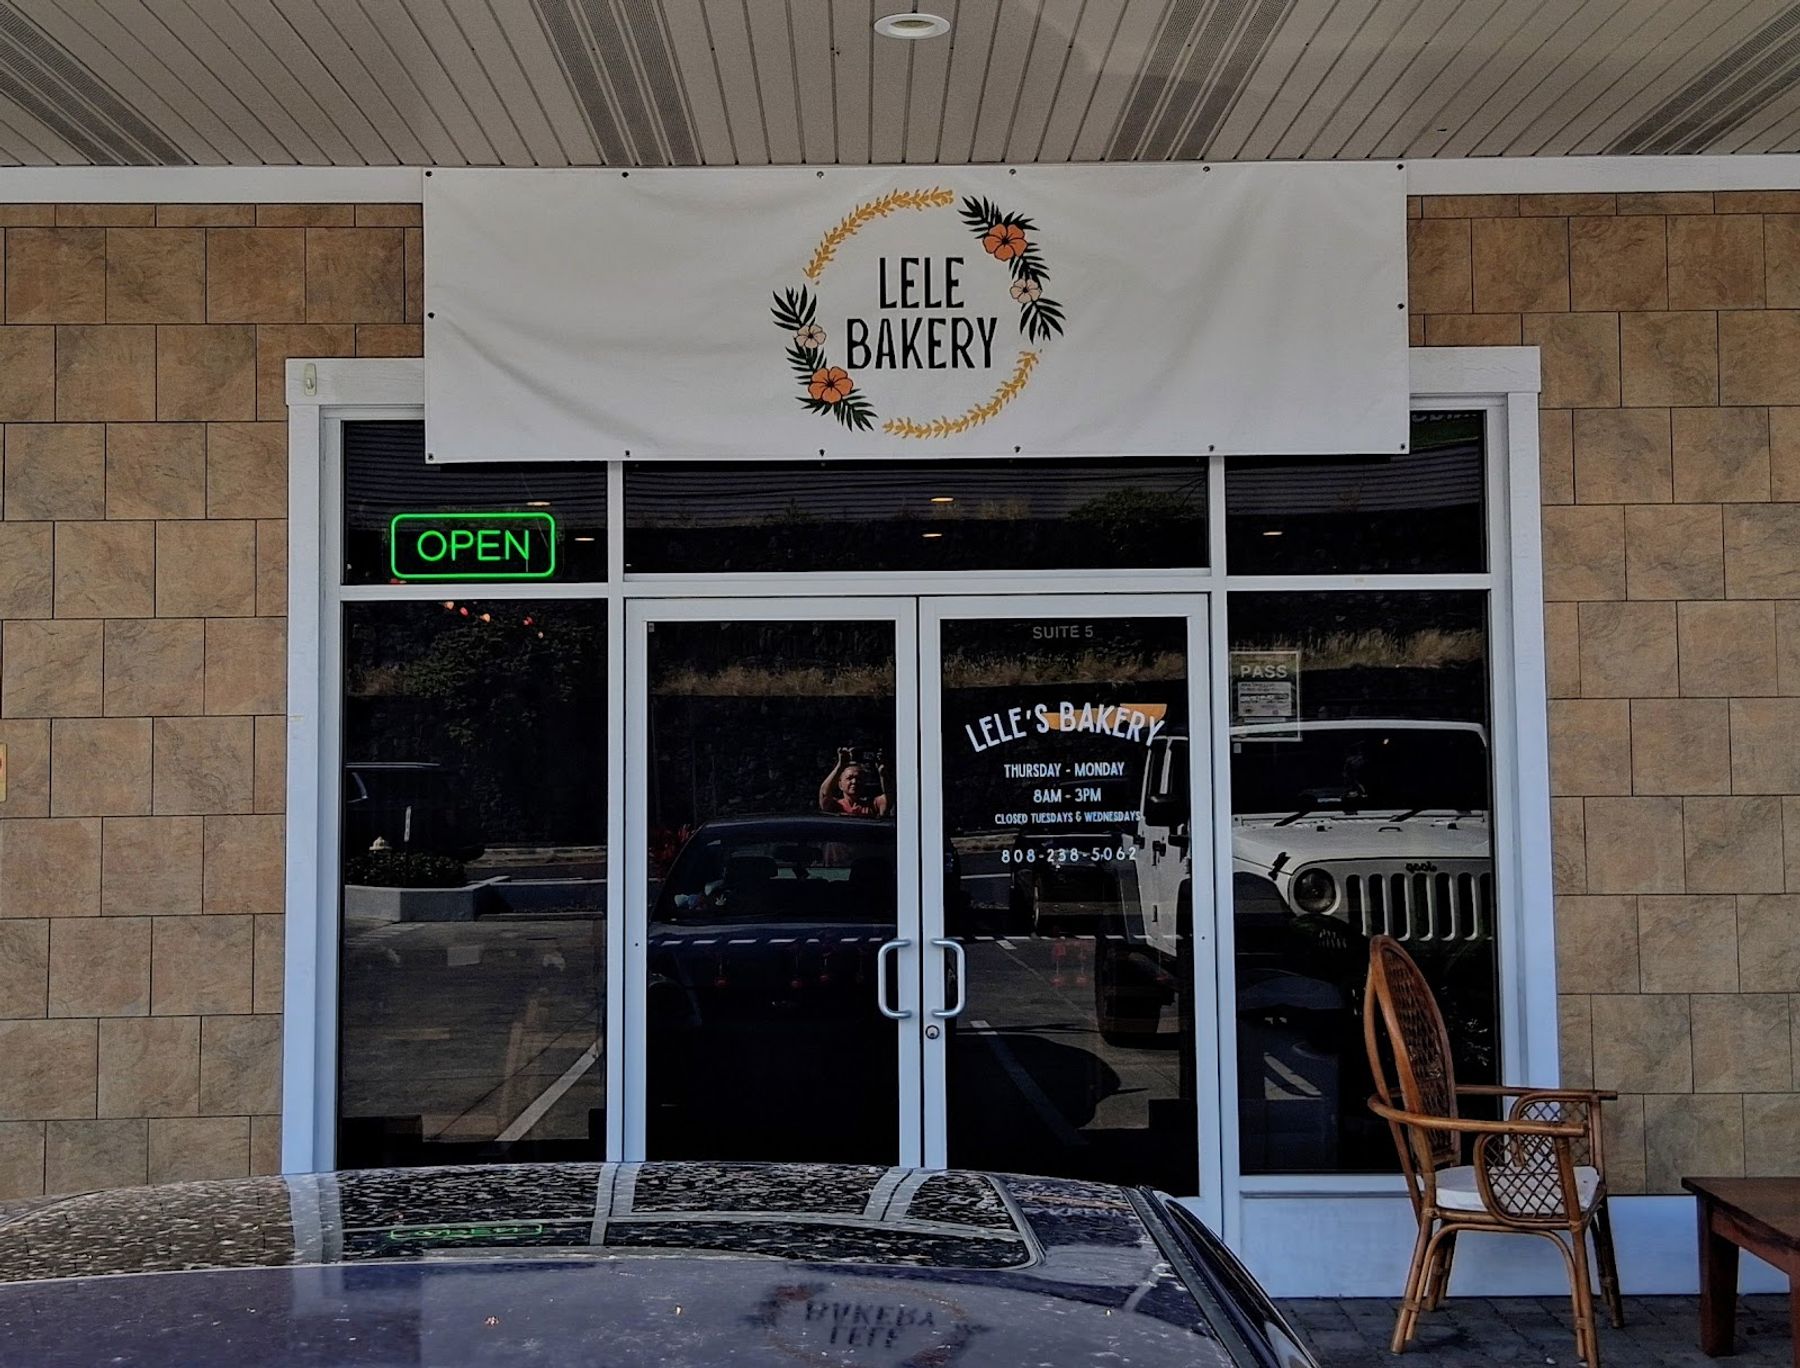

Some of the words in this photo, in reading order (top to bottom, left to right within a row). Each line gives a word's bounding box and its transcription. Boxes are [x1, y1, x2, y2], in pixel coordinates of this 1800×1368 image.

[879, 257, 964, 309] LELE
[847, 317, 998, 369] BAKERY
[417, 530, 530, 562] OPEN
[1032, 626, 1080, 640] SUITE
[1085, 626, 1094, 638] 5
[1240, 664, 1289, 679] PASS
[965, 703, 1050, 753] LELE'S
[1059, 701, 1166, 747] BAKERY
[1003, 763, 1062, 779] THURSDAY
[1074, 761, 1126, 777] MONDAY
[1033, 788, 1062, 803] 8AM
[1074, 787, 1102, 802] 3PM
[994, 812, 1029, 825] CLOSED
[1031, 811, 1074, 824] TUESDAYS
[1075, 811, 1082, 823] &
[1083, 810, 1141, 823] WEDNESDAYS
[1001, 846, 1138, 864] 808-238-5062
